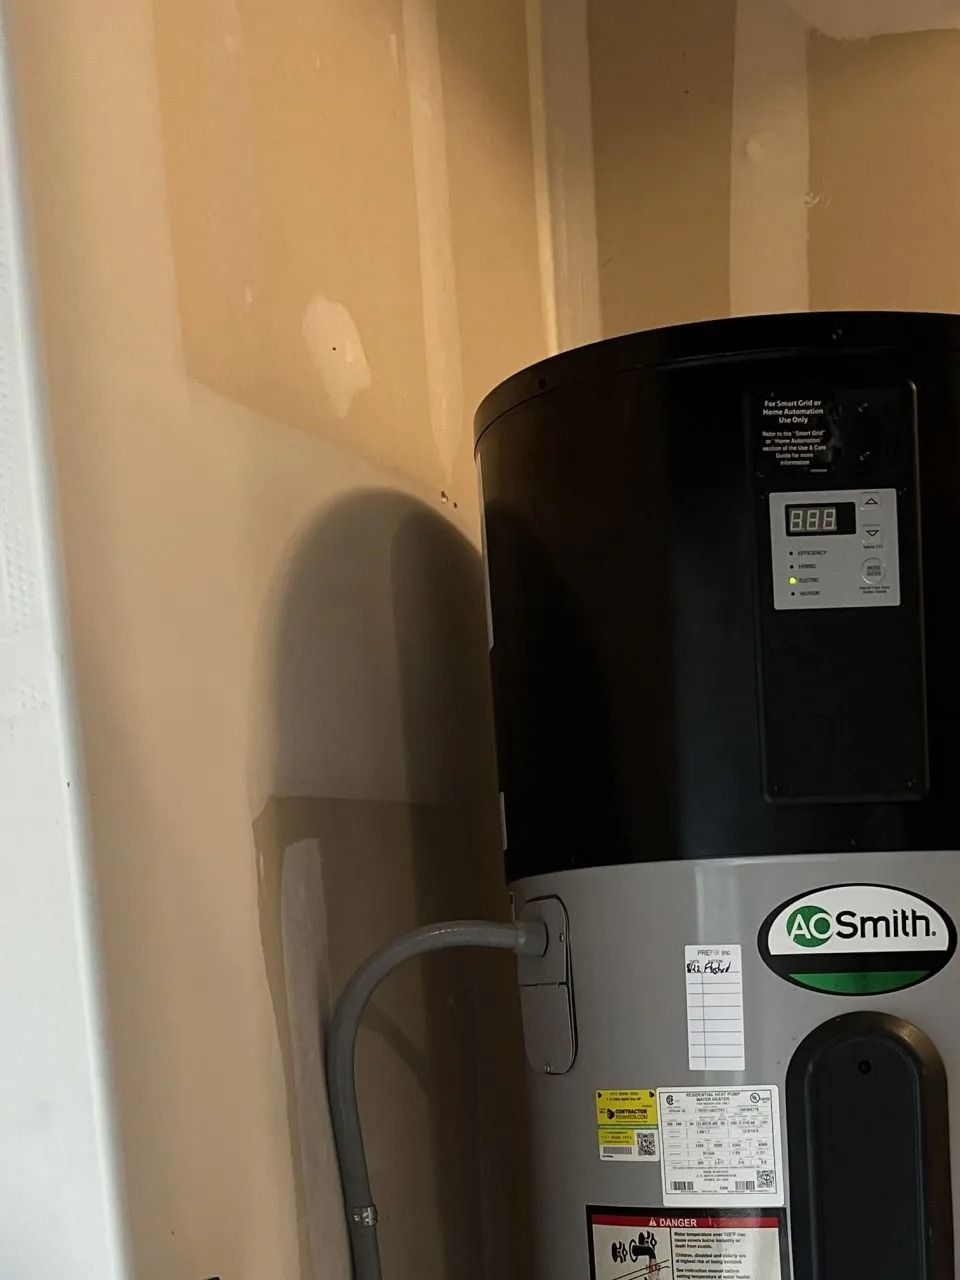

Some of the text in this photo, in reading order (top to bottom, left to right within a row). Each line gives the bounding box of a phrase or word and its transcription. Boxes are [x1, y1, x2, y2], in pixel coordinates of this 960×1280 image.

[798, 399, 813, 407] Grid
[792, 417, 809, 425] Only
[659, 1218, 698, 1228] DANGER
